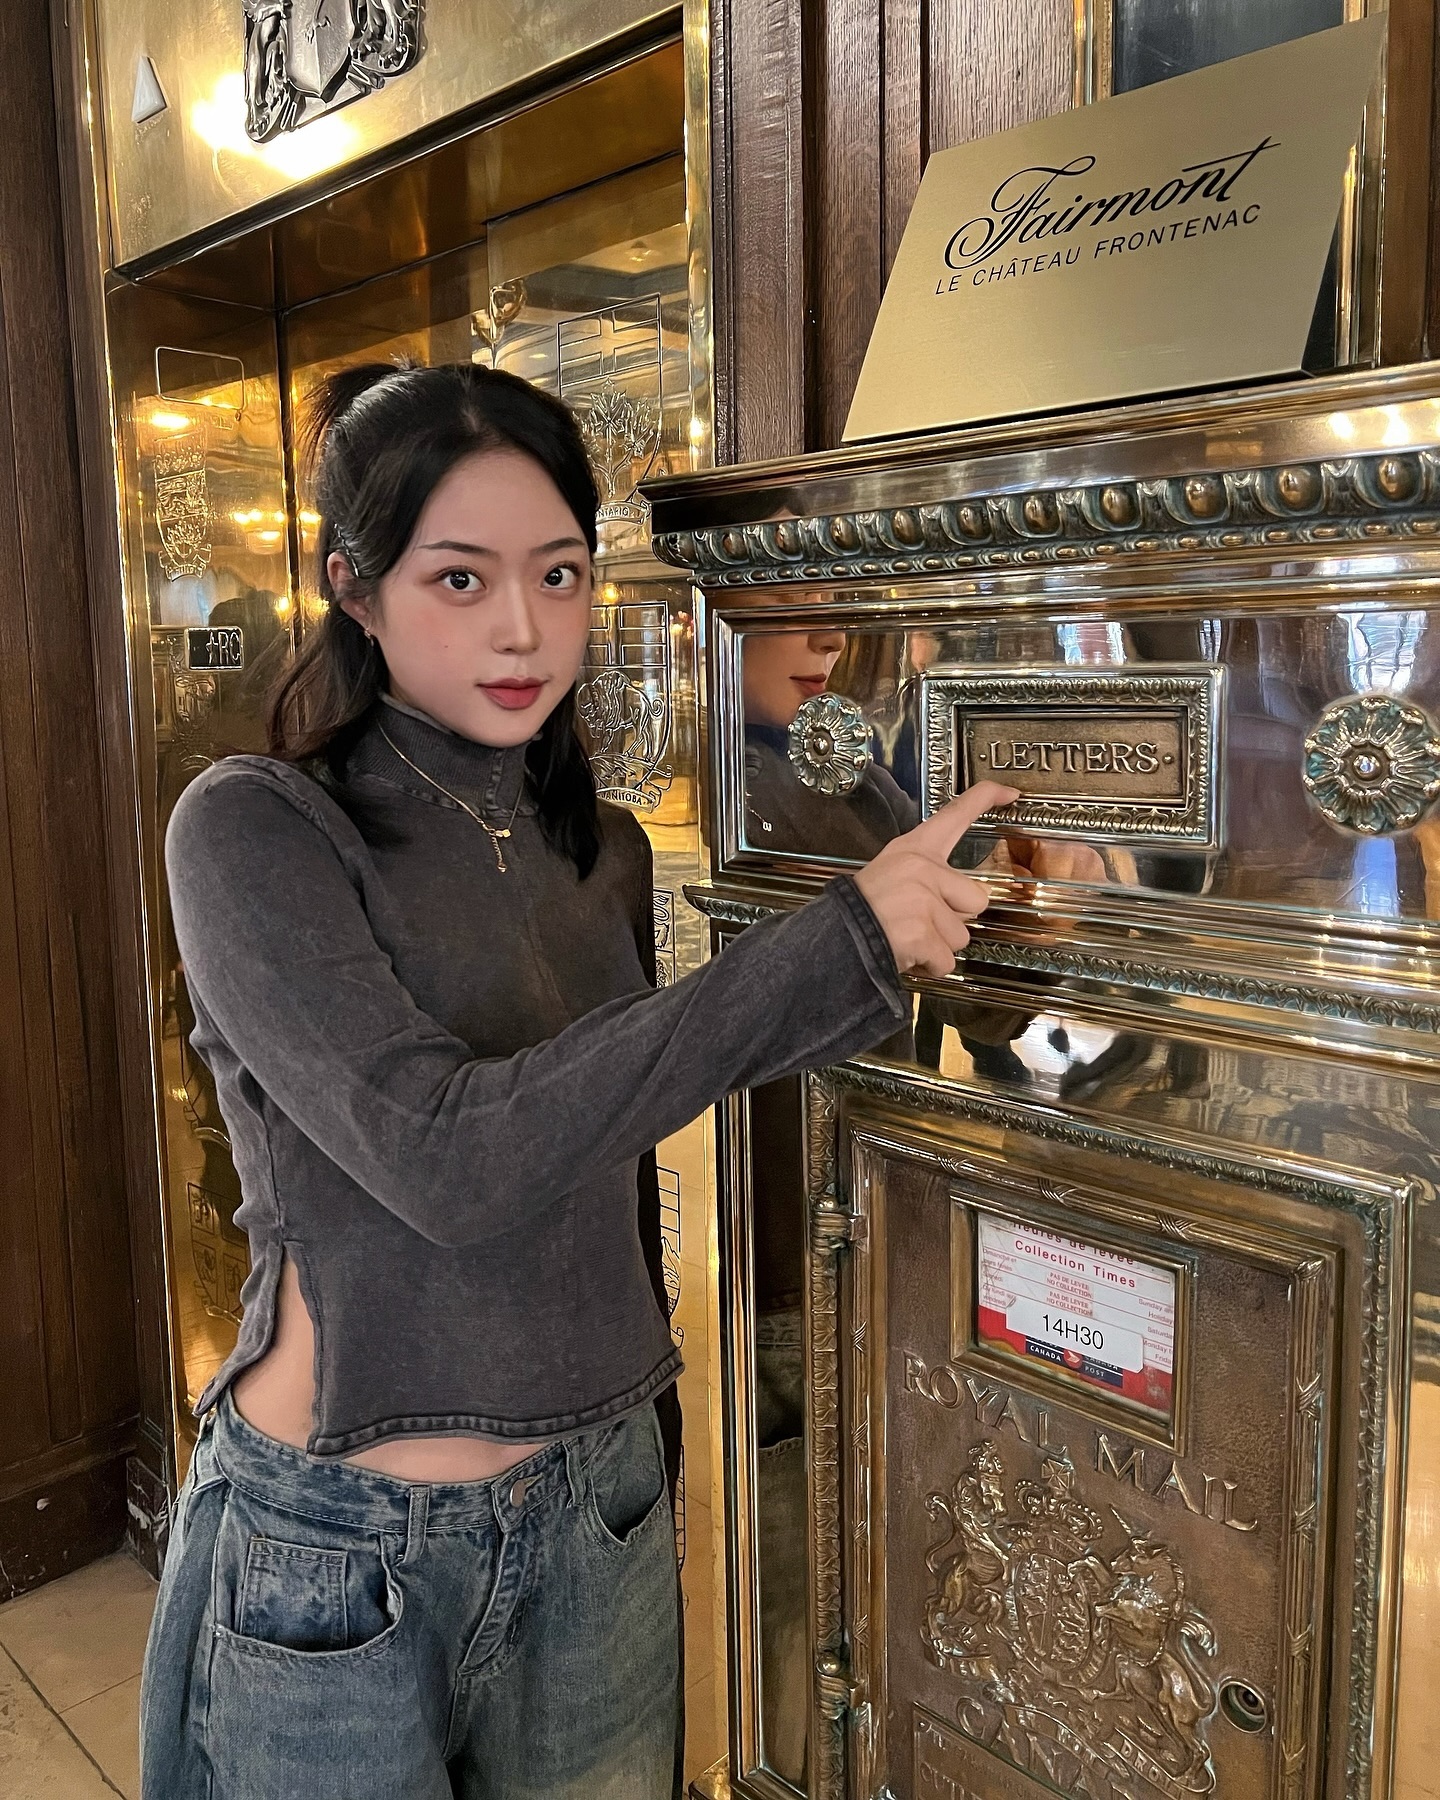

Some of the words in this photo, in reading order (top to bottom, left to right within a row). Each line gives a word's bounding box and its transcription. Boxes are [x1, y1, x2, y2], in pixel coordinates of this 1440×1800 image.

[944, 136, 1281, 269] Fairmont
[935, 275, 962, 294] LE
[973, 246, 1080, 285] CHÂTEAU
[1094, 204, 1261, 258] FRONTENAC
[990, 741, 1160, 774] LETTERS
[1015, 1240, 1085, 1272] Collection
[1093, 1265, 1136, 1288] Times
[1043, 1314, 1104, 1350] 14H30
[1030, 1345, 1061, 1362] CANADA
[1084, 1365, 1105, 1377] POST
[903, 1350, 1068, 1455] ROYAL
[1095, 1432, 1258, 1532] MAIL
